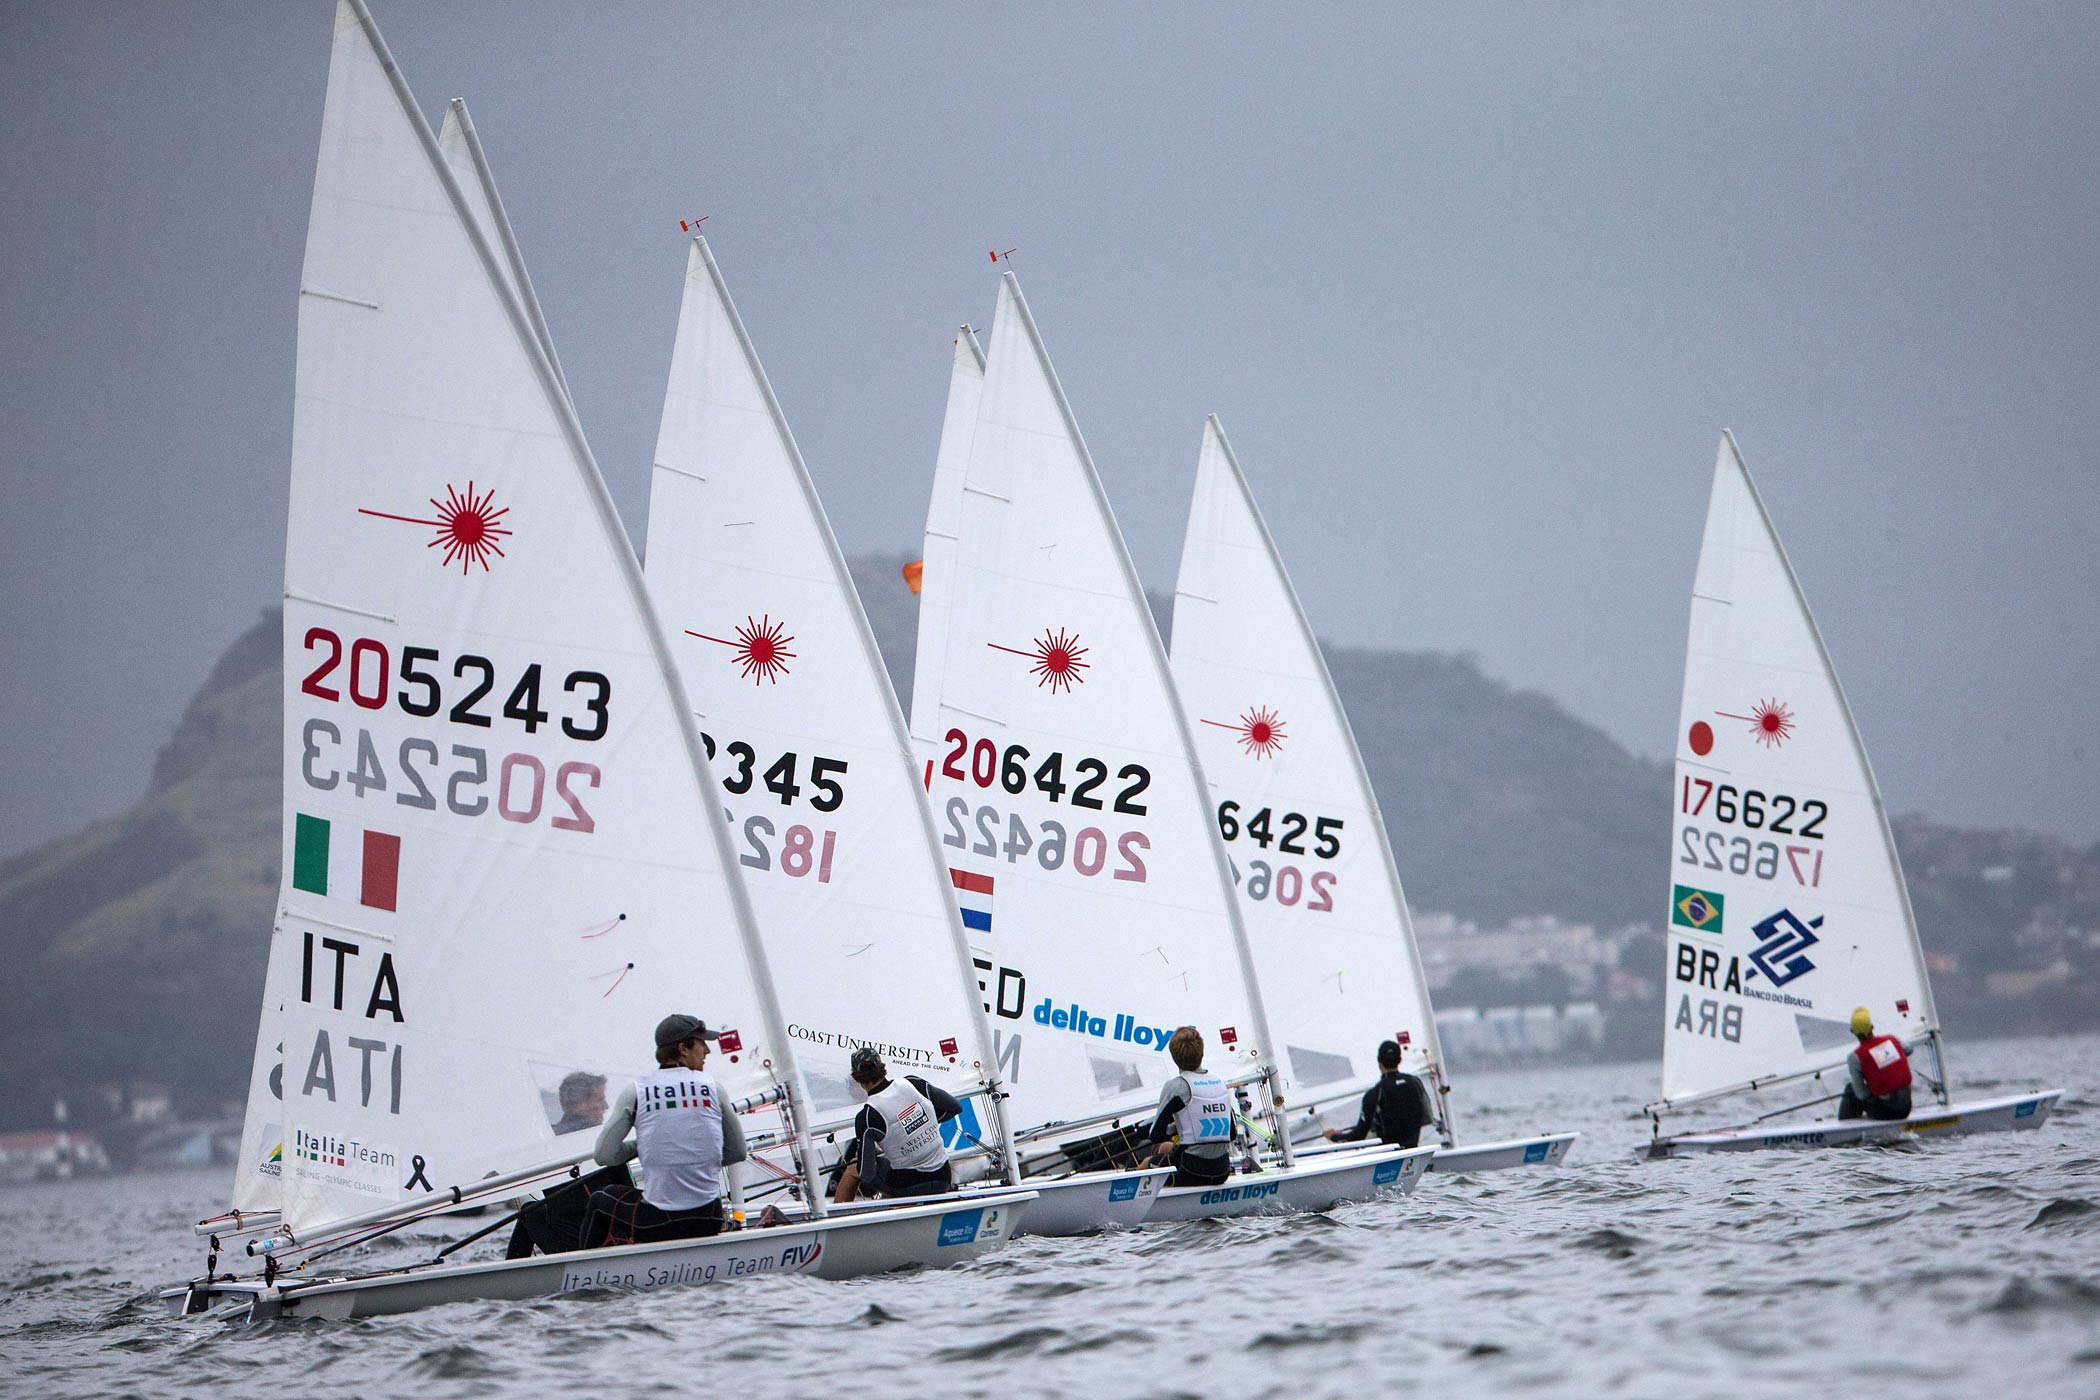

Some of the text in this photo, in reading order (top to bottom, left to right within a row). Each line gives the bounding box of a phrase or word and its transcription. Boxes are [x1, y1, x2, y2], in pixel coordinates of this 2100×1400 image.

[302, 627, 611, 741] 205243
[700, 732, 848, 812] 345
[942, 727, 1151, 816] 206422
[1682, 775, 1828, 839] 176622
[1218, 800, 1344, 859] 6425
[301, 931, 404, 1022] ITA
[1676, 942, 1741, 994] BRA
[1743, 986, 1771, 1000] BANCO
[1784, 994, 1813, 1008] BRASIL
[788, 1024, 834, 1045] COAST
[1033, 997, 1196, 1052] delta lloy
[645, 1081, 710, 1101] Italia
[1202, 1103, 1226, 1114] NED
[296, 1129, 395, 1167] Italia Team
[259, 1168, 281, 1177] SAILING
[260, 1162, 282, 1171] AUSTR
[296, 1168, 320, 1180] SAILING
[325, 1175, 352, 1188] OLYMPIC
[354, 1182, 382, 1194] CLASSES
[1200, 1181, 1280, 1205] delta lloyd
[781, 1244, 812, 1267] FIV
[563, 1256, 774, 1291] Italian Sailing Team
